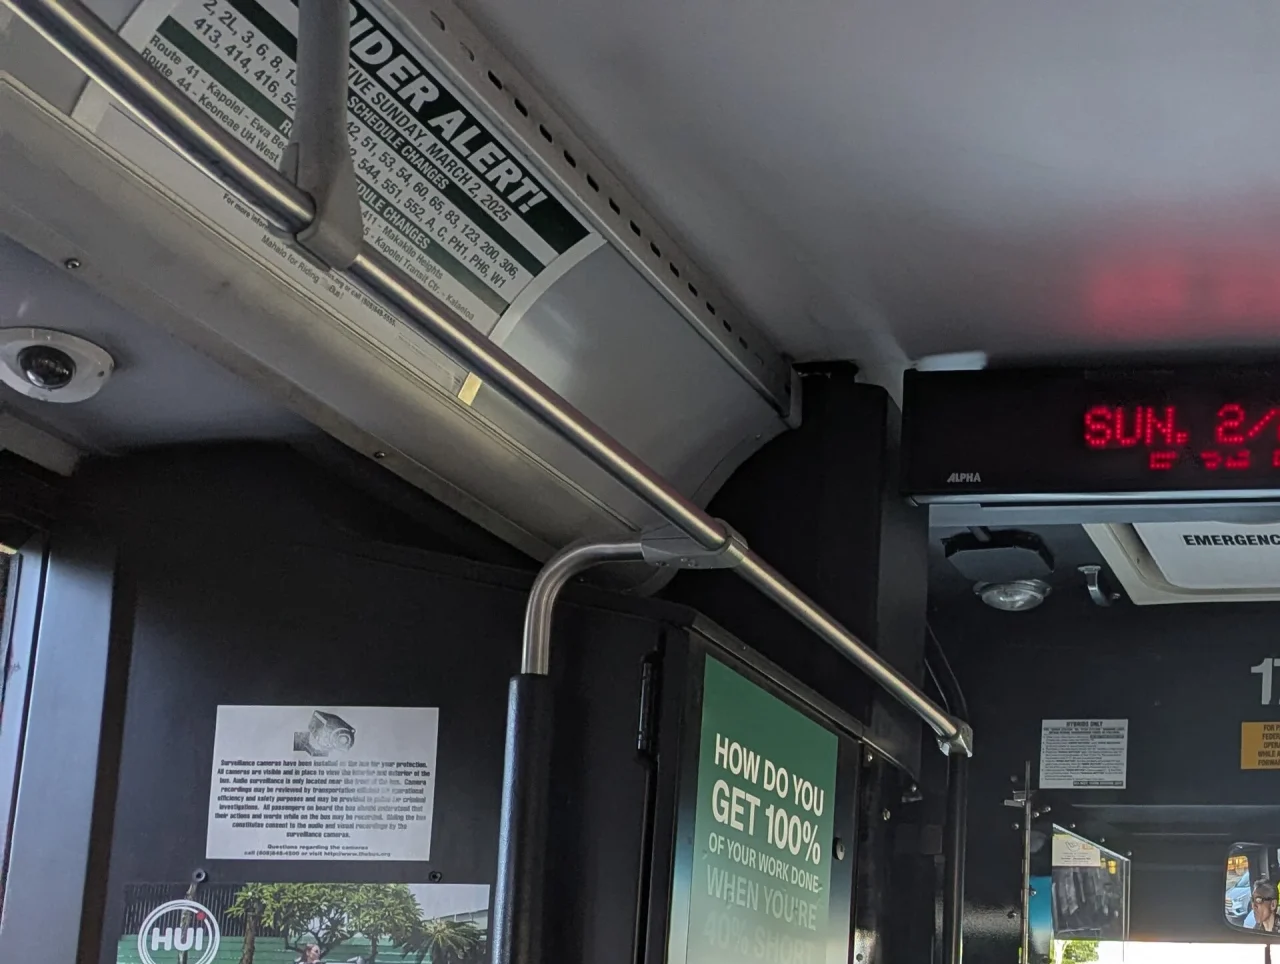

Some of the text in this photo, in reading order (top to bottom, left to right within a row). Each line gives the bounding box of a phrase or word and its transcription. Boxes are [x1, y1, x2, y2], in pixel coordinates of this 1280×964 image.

[347, 96, 402, 147] SCHEDULE
[401, 147, 447, 189] CHANGES
[350, 3, 549, 214] IDER ALERT!
[141, 48, 173, 77] Route
[177, 77, 192, 91] 44
[199, 94, 240, 131] Keoneae
[240, 127, 257, 144] UH
[256, 139, 279, 162] West
[374, 238, 402, 262] Kapolei
[402, 259, 427, 282] Transit
[150, 34, 182, 65] Route
[186, 65, 200, 79] 41
[207, 81, 243, 118] Kapolei
[250, 117, 271, 139] Ewa
[382, 227, 416, 256] Makakilo
[416, 255, 442, 278] Heights
[194, 17, 505, 288] 413, 414, 416, 544, 551, 552, A, C, PH1, PH6, W1
[242, 31, 255, 48] 3,
[256, 44, 269, 61] 6,
[270, 56, 283, 73] 8,
[359, 136, 380, 155] 51,
[377, 151, 398, 171] 53,
[394, 166, 414, 186] 54,
[411, 181, 431, 200] 60,
[427, 195, 447, 215] 65,
[443, 209, 462, 228] 83,
[459, 223, 482, 245] 123,
[478, 241, 501, 262] 200,
[497, 258, 520, 279] 306,
[371, 92, 509, 221] SUNDAY, MARCH 2, 2025
[383, 208, 429, 248] CHANGES
[1084, 405, 1189, 448] SUN.
[946, 472, 981, 483] ALPHA
[715, 733, 824, 816] HOW DO YOU
[709, 832, 819, 893] OF YOUR WORK DONE
[712, 779, 820, 865] GET 100%
[151, 927, 203, 950] HUI
[707, 864, 817, 930] WHEN YOU'RE
